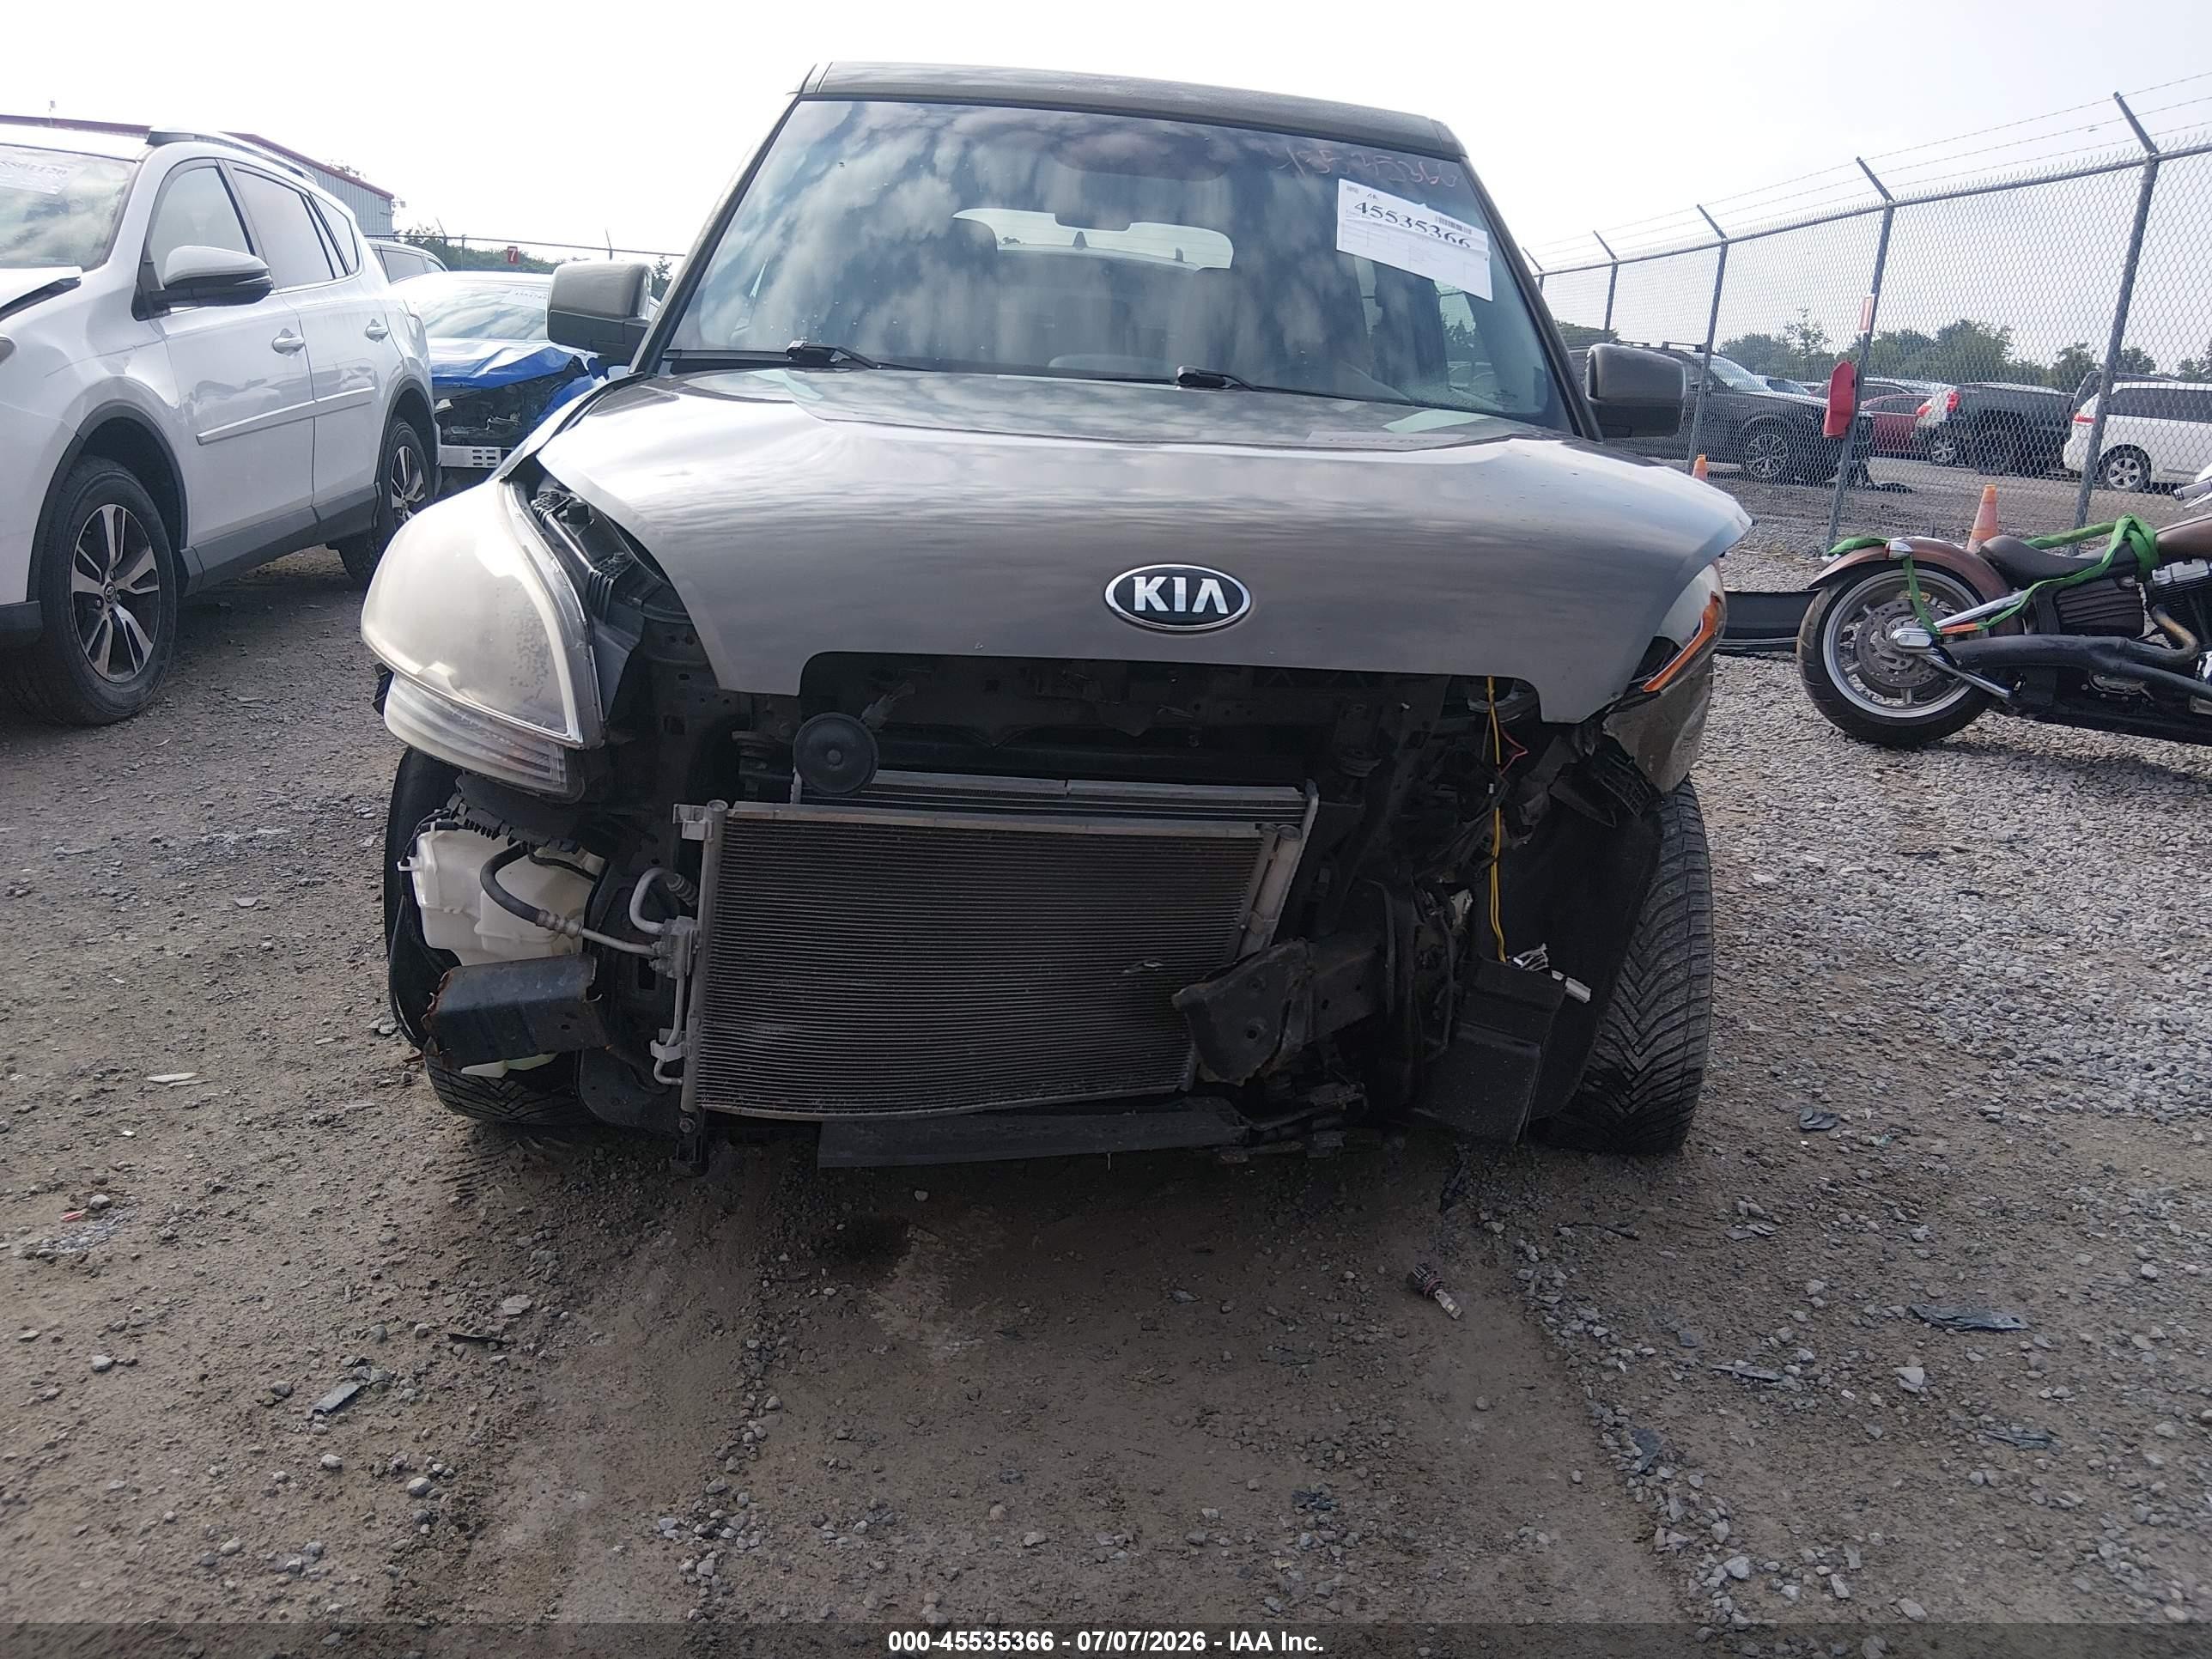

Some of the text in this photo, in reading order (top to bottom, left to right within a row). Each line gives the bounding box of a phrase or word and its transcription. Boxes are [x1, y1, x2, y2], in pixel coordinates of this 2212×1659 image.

[1353, 201, 1471, 249] 45535366
[507, 247, 518, 262] 7
[1133, 576, 1230, 615] KIA
